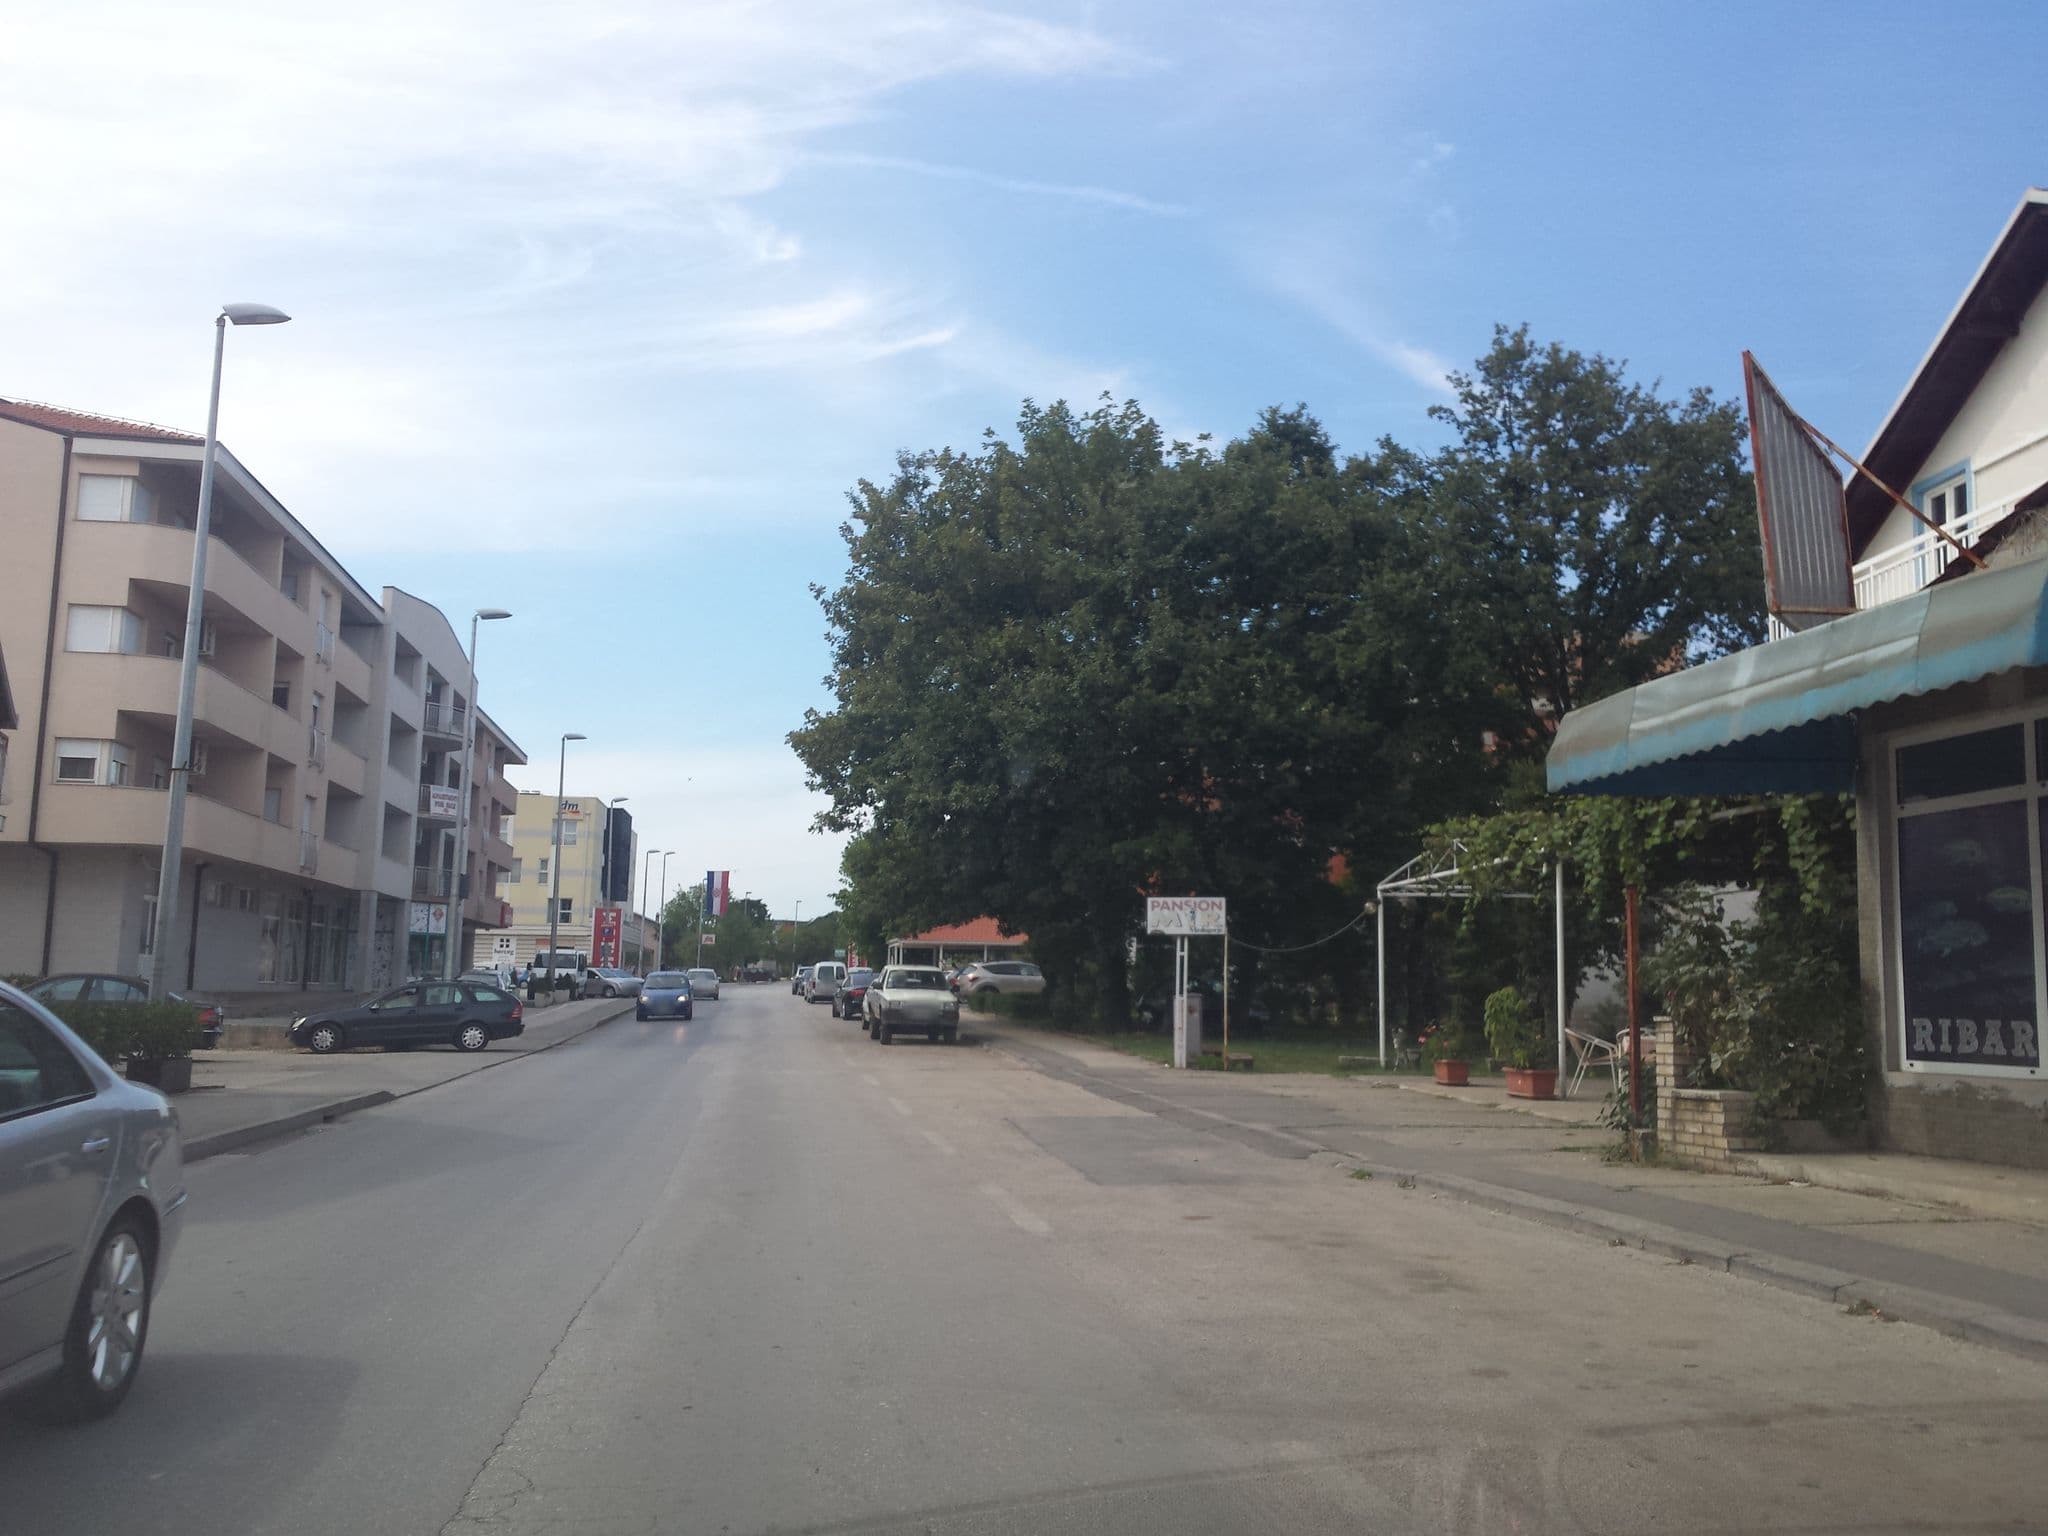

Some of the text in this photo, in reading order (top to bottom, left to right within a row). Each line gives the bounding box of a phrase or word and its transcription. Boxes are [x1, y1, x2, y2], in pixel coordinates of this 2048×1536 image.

[561, 800, 578, 810] dm
[1151, 899, 1223, 912] PANSION
[1912, 1017, 2038, 1057] RIBAR
